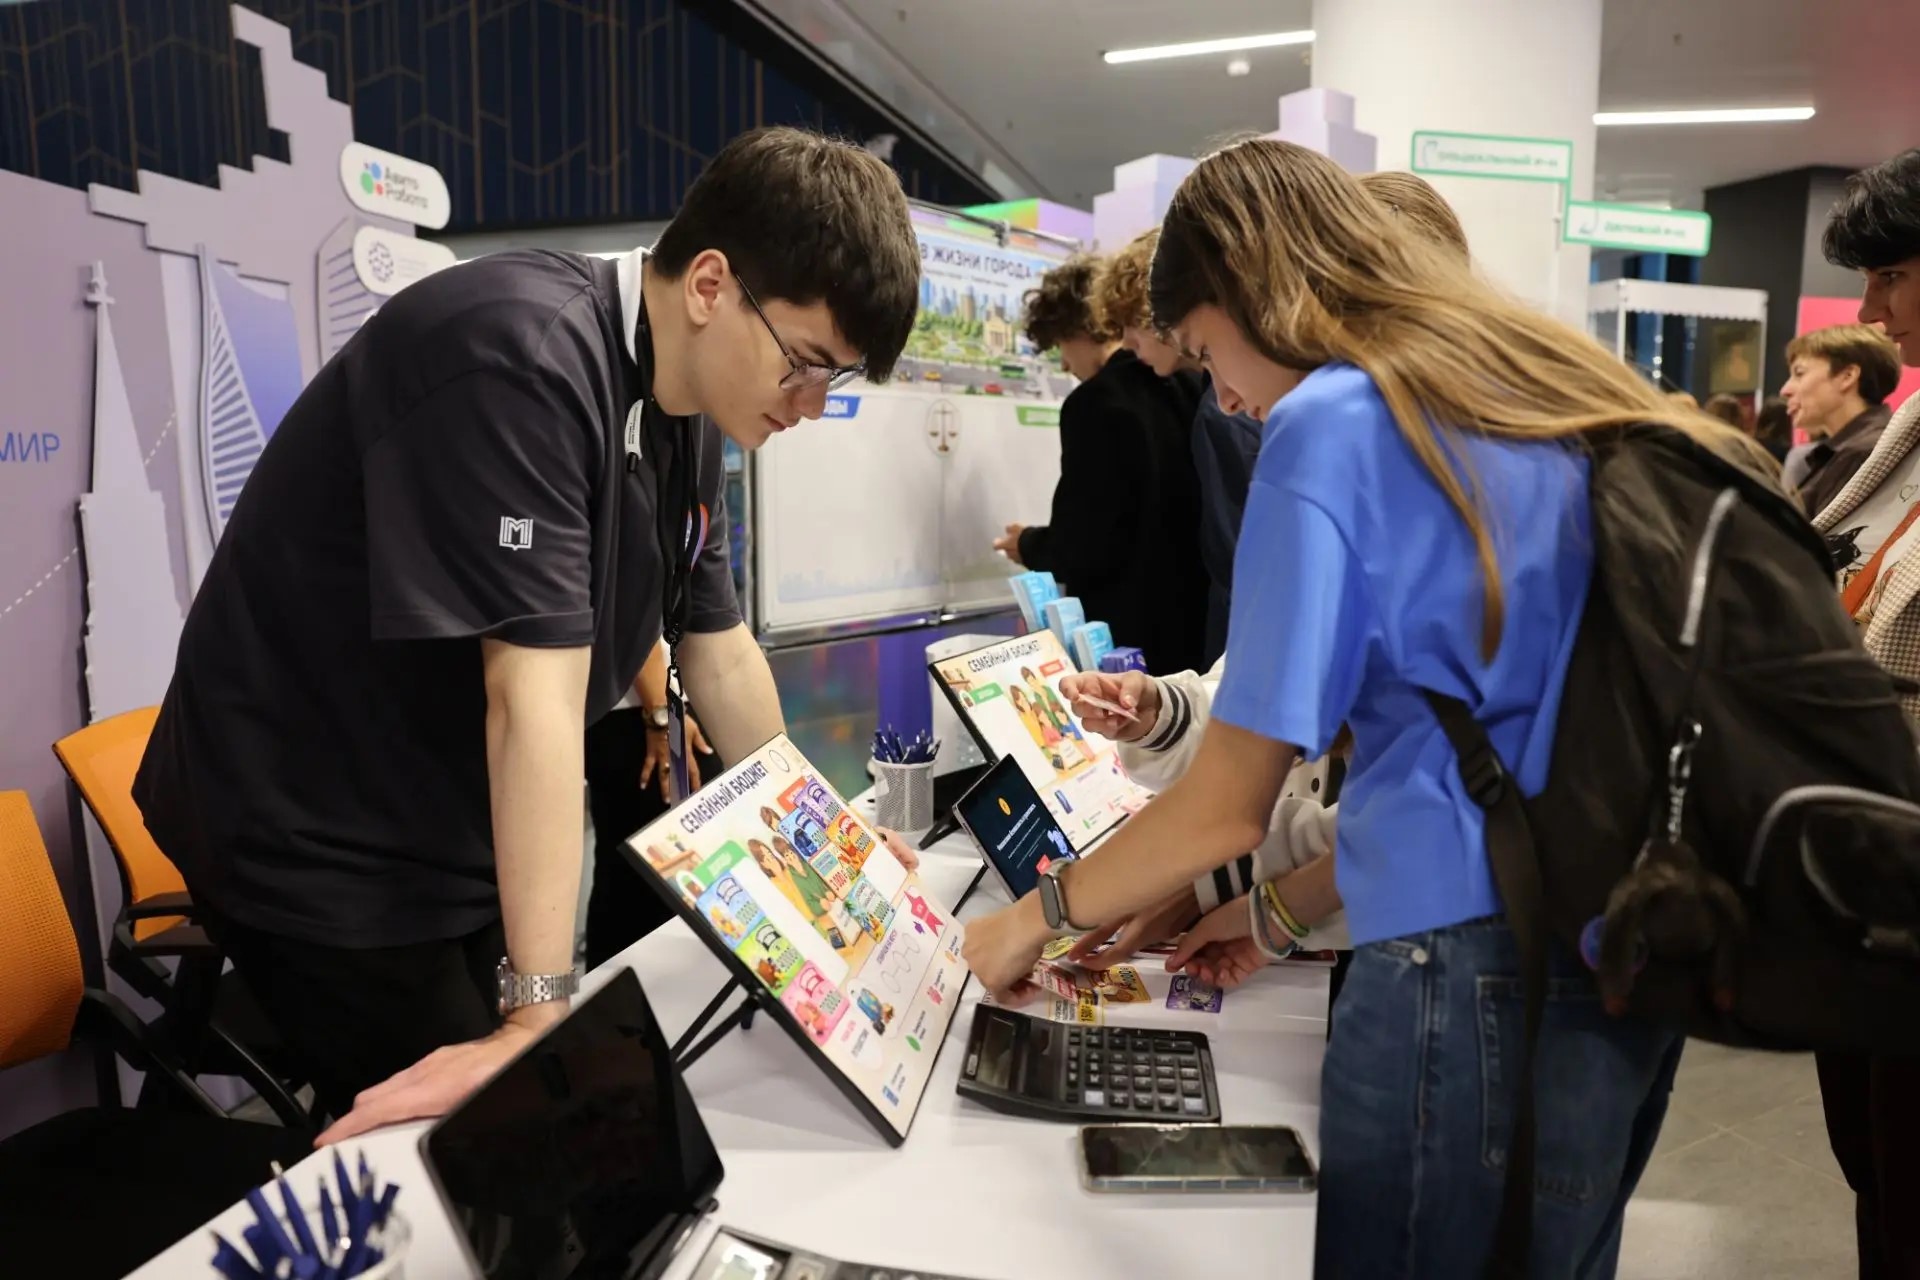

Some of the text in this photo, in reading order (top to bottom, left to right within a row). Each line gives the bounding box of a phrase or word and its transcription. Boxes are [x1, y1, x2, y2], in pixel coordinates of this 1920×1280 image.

[932, 246, 980, 269] ЖИЗНИ
[984, 256, 1032, 279] ГОРОДА
[680, 782, 738, 834] СЕМЕЙНЫЙ
[729, 760, 769, 796] БЮДЖЕТ
